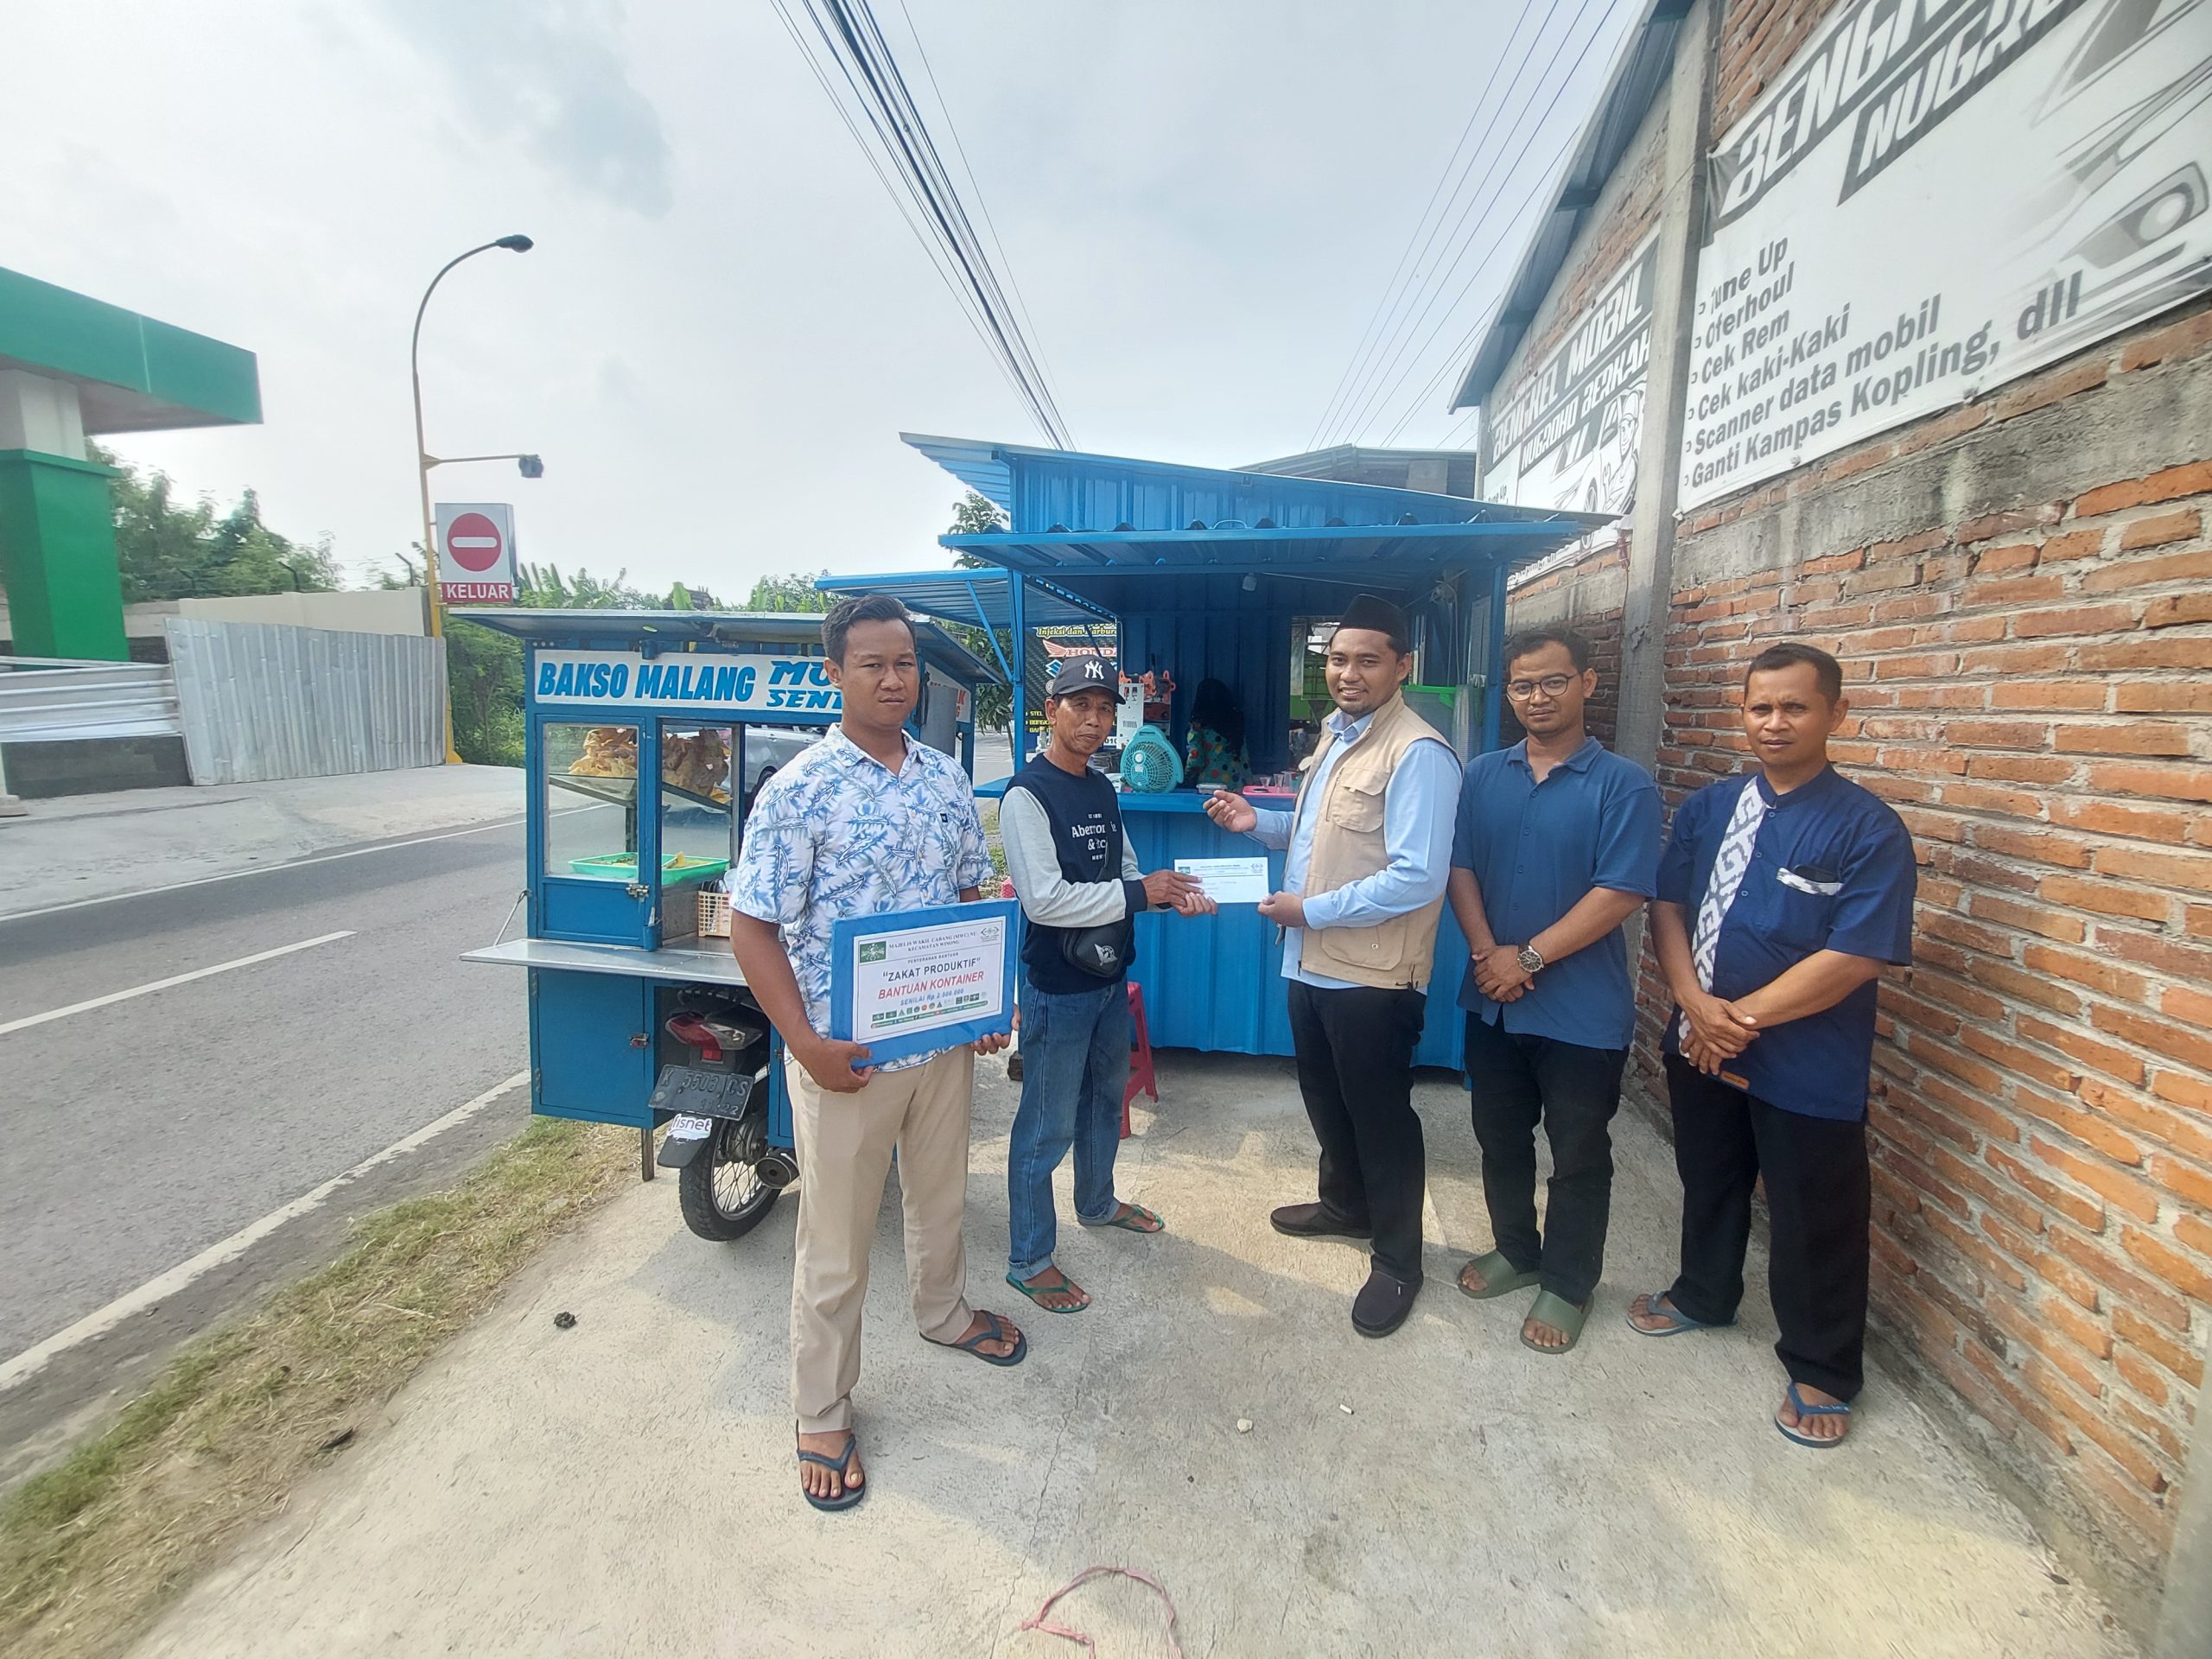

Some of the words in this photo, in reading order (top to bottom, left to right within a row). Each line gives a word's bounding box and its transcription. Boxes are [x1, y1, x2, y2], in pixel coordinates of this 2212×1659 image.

[1758, 237, 1788, 276] Up
[1565, 262, 1643, 389] MOBIL
[1705, 261, 1795, 349] Oferhoul
[1691, 442, 1739, 488] Ganti
[1745, 400, 1842, 466] Kampas
[2017, 270, 2083, 340] dll
[1694, 394, 1774, 454] Scanner
[1779, 361, 1837, 411] data
[1845, 293, 1942, 378] mobil
[1698, 383, 1732, 421] Cek
[1737, 302, 1851, 400] kaki-Kaki
[1701, 345, 1735, 385] Cek
[1740, 309, 1789, 360] Rem
[447, 584, 510, 599] KELUAR
[537, 662, 629, 698] BAKSO
[634, 664, 757, 702] MALANG
[878, 982, 927, 1000] BANTUAN
[929, 970, 984, 990] KONTAINER
[926, 993, 935, 1001] Rp
